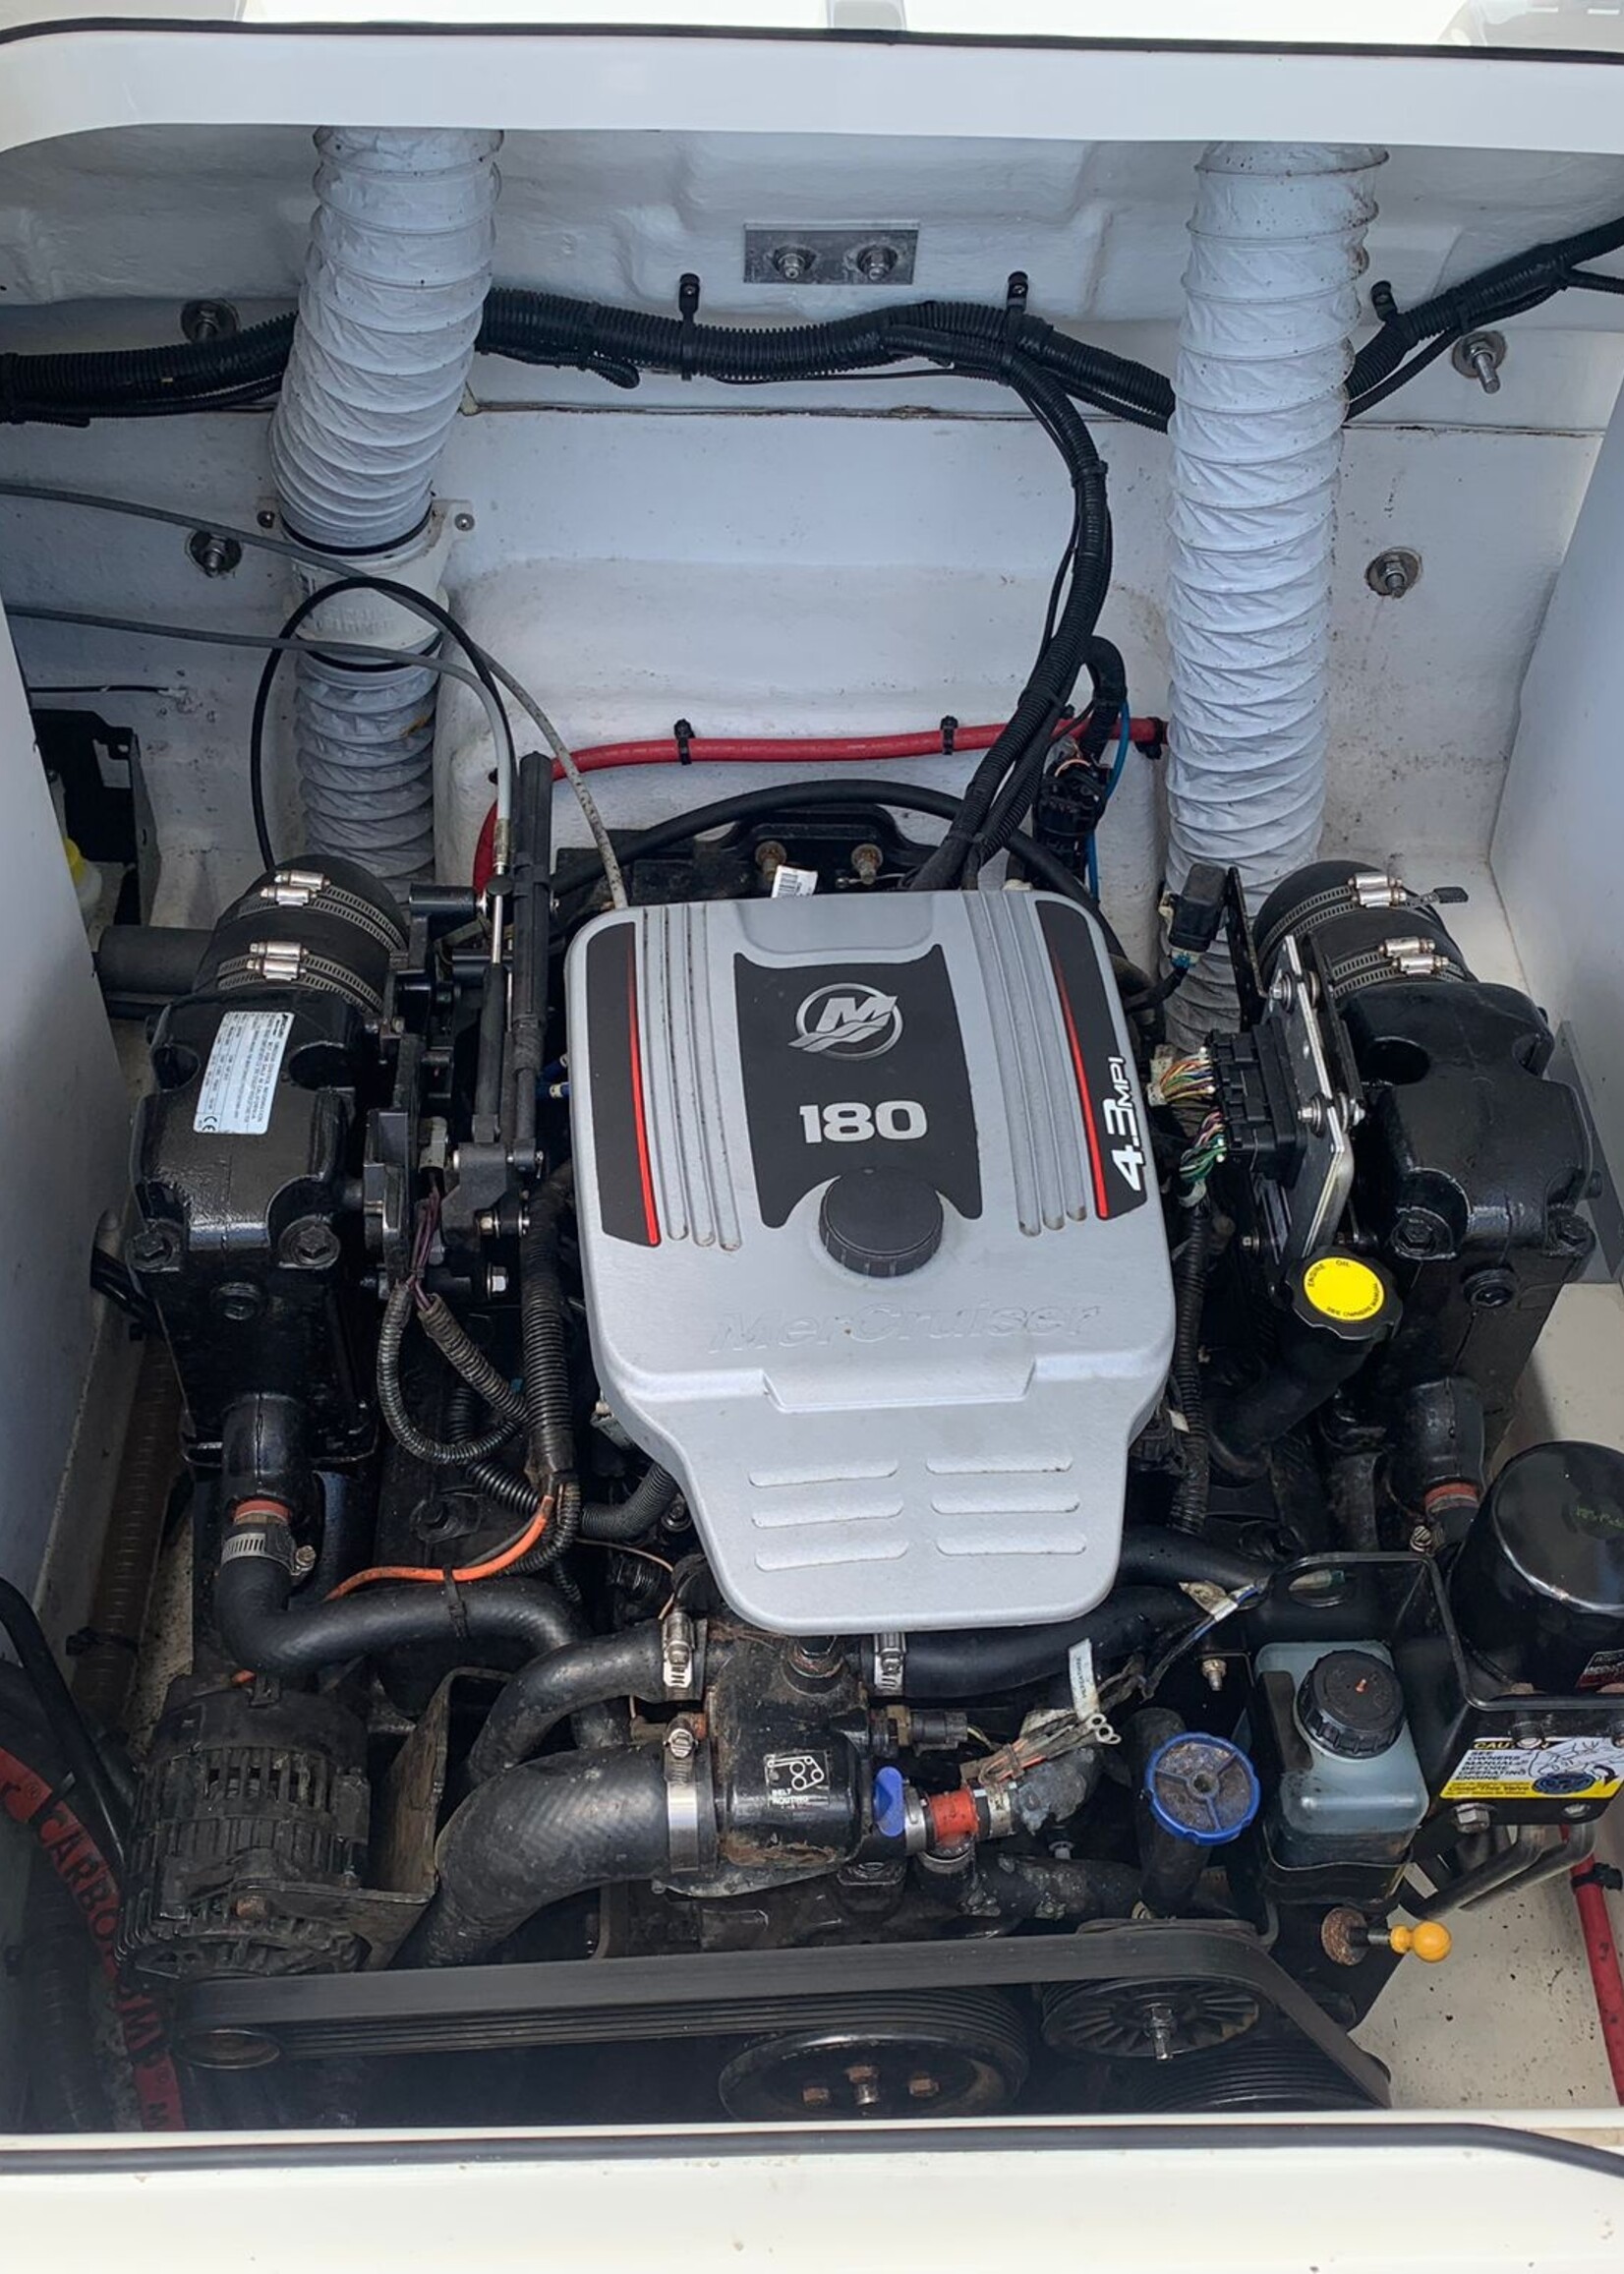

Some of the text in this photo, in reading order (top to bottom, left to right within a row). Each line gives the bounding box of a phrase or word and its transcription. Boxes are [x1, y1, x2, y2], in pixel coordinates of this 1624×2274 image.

[799, 1100, 927, 1144] 180
[1307, 1259, 1351, 1288] ENGINE OIL
[708, 1303, 1101, 1354] MerCruiser
